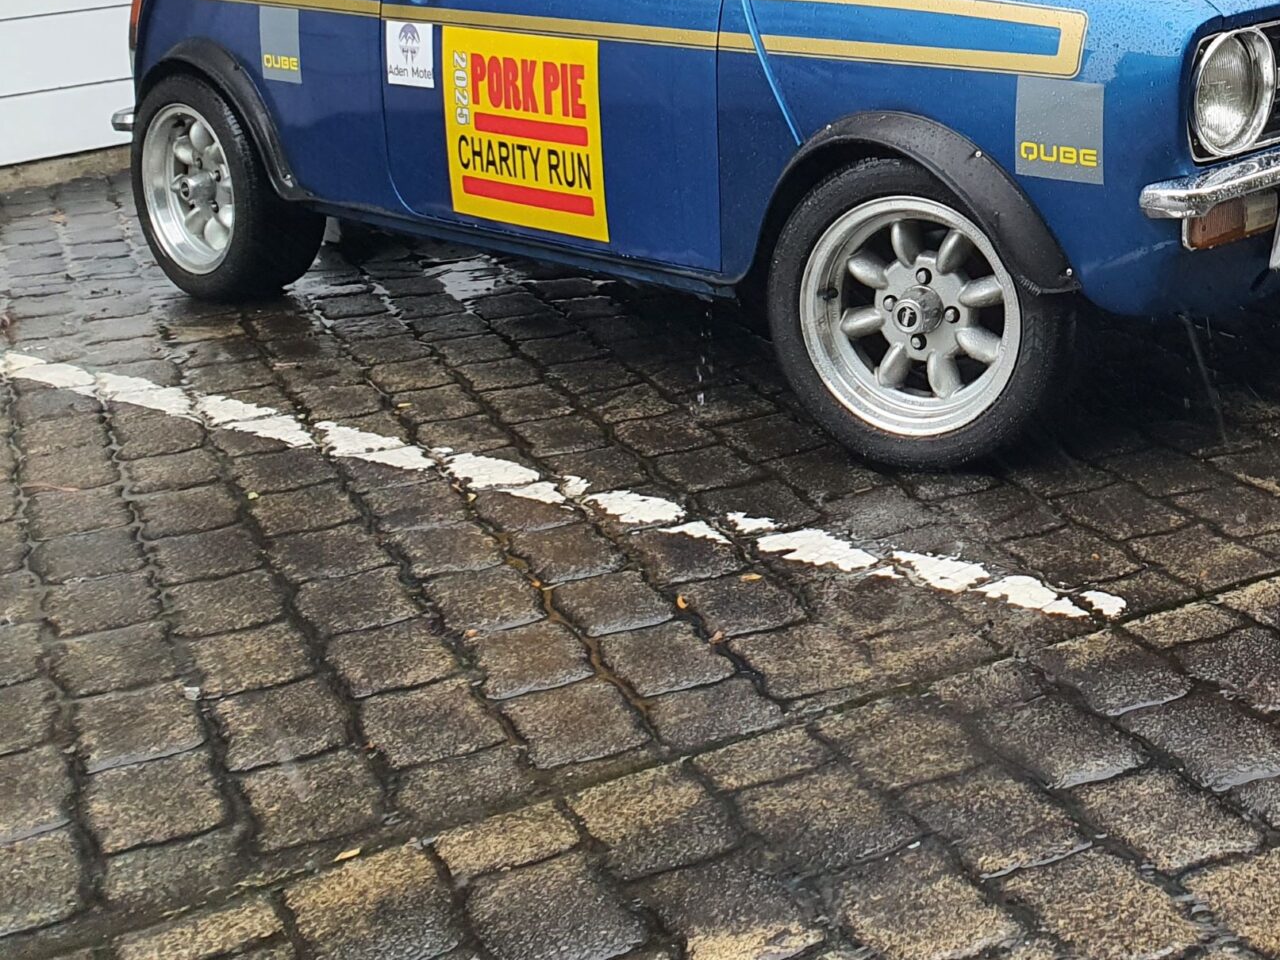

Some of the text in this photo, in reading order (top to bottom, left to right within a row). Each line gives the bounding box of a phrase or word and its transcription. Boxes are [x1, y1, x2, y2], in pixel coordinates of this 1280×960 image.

[263, 53, 299, 71] QUBE
[389, 64, 408, 77] Aden
[453, 50, 469, 125] 2025
[471, 53, 587, 119] PORK PIE
[458, 134, 592, 190] CHARITY RUN
[1020, 141, 1097, 167] QUBE
